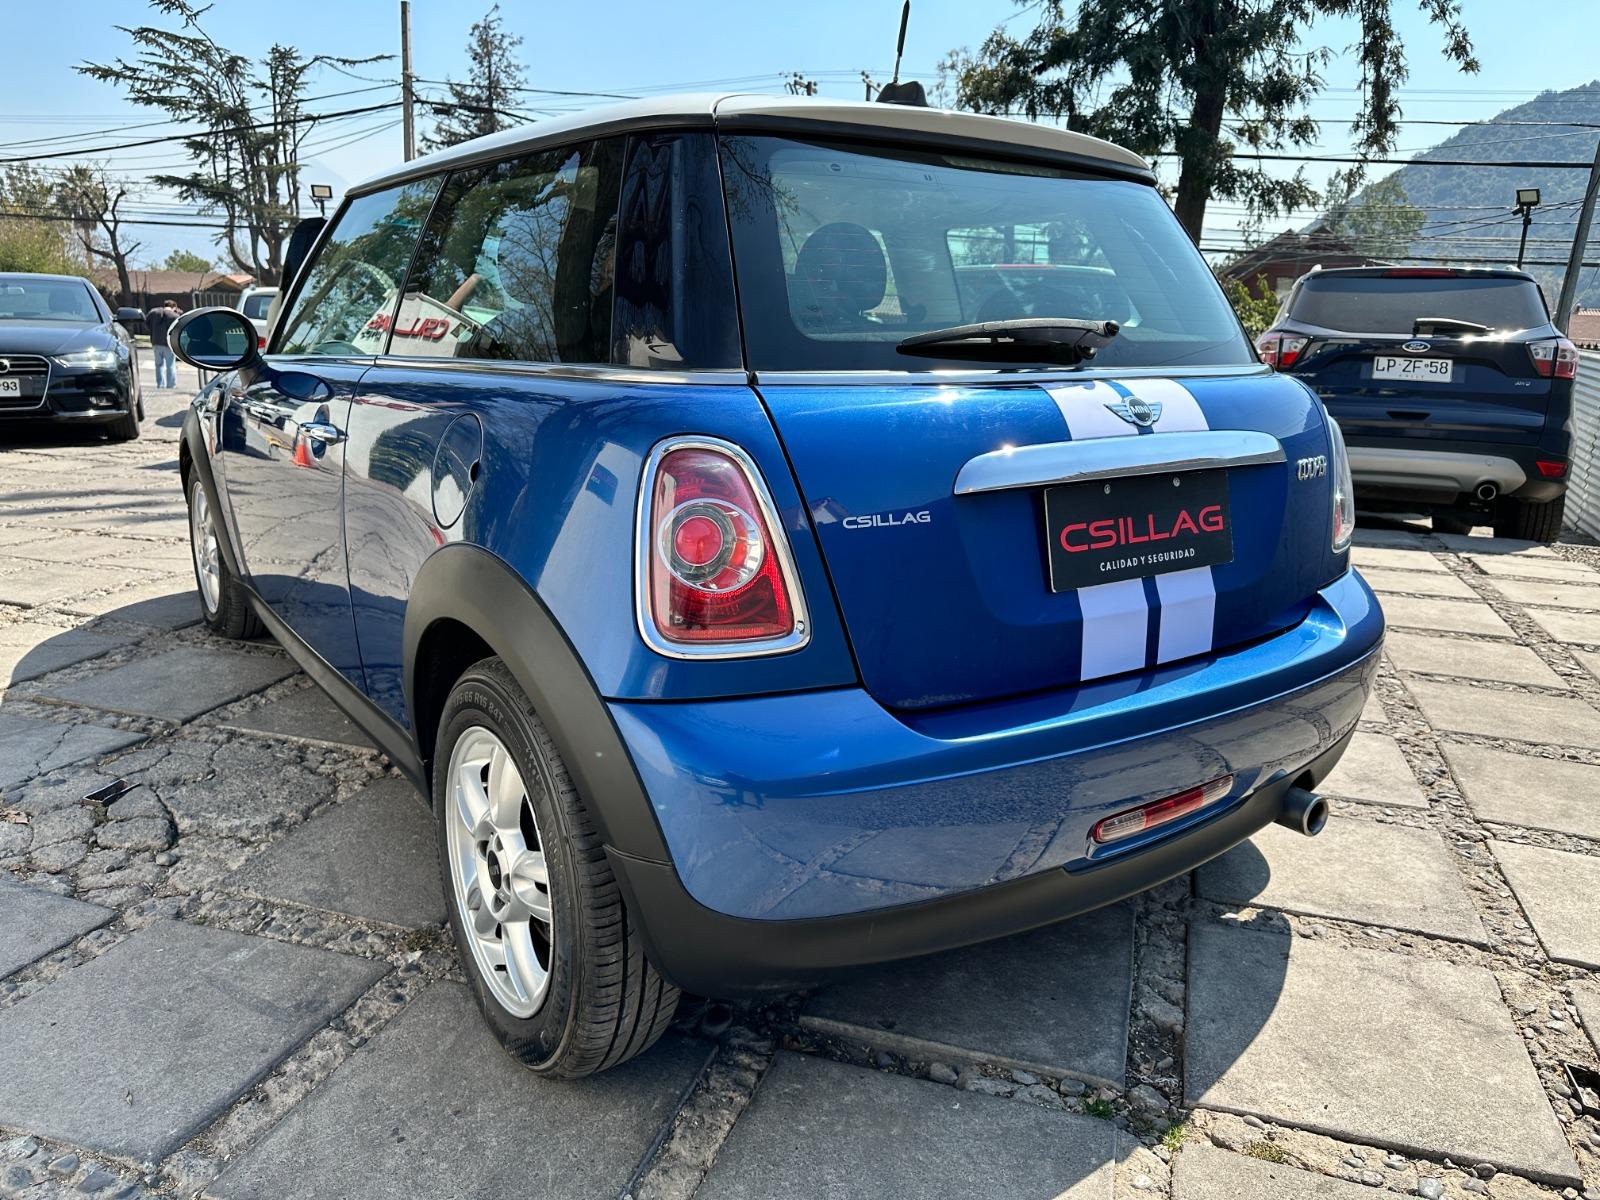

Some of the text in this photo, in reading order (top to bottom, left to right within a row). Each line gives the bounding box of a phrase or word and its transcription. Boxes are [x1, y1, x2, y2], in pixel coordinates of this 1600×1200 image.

[1129, 405, 1151, 414] MINI
[842, 510, 931, 529] CSILLAG
[1060, 505, 1224, 553] CSILLAG
[1100, 548, 1195, 572] CALIDAD Y SEGURIDAD
